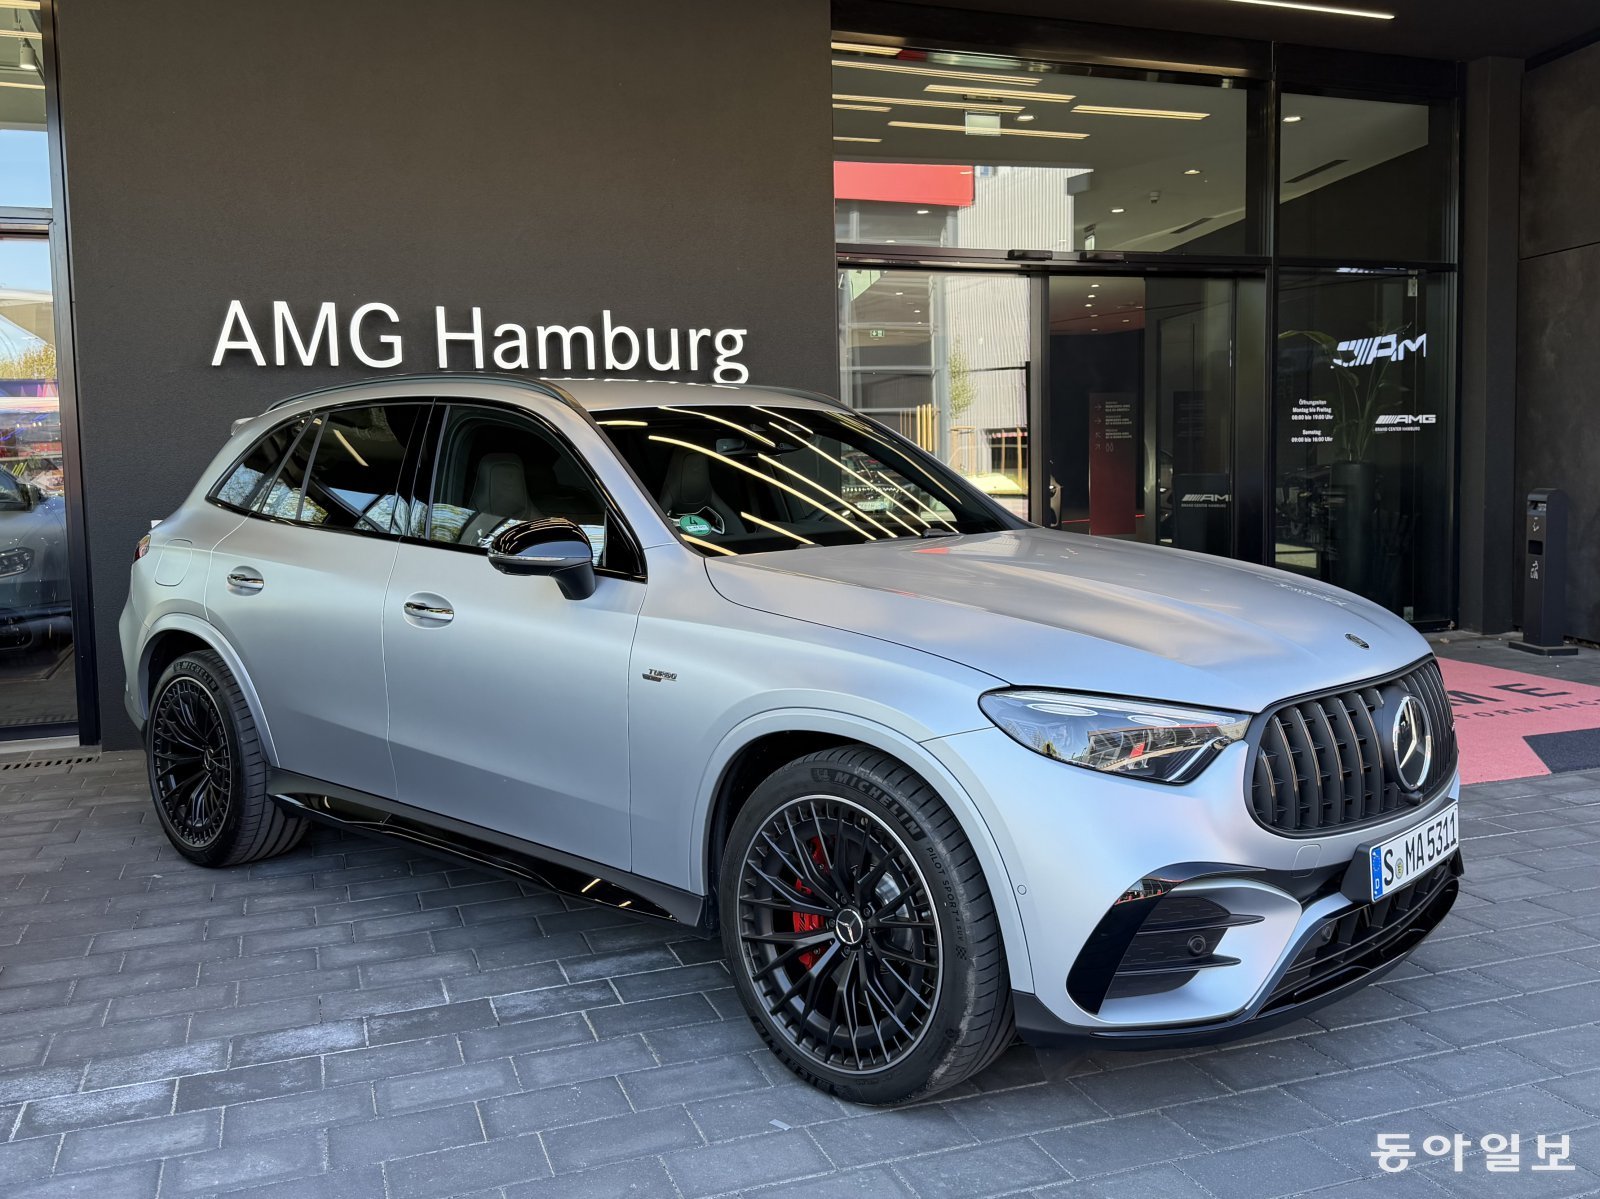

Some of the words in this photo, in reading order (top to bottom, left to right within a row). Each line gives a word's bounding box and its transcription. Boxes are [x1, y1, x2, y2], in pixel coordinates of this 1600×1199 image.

[211, 300, 403, 368] AMG
[435, 305, 749, 384] Hamburg
[1394, 415, 1436, 424] AMG
[1200, 494, 1231, 502] AM
[1454, 698, 1600, 720] FORMANC
[834, 771, 922, 837] MICHELIN
[1384, 848, 1394, 886] S
[1405, 832, 1425, 875] MA
[1427, 812, 1457, 861] 5311
[926, 847, 946, 875] PILOT
[943, 880, 959, 915] SPORT
[1375, 879, 1380, 889] D
